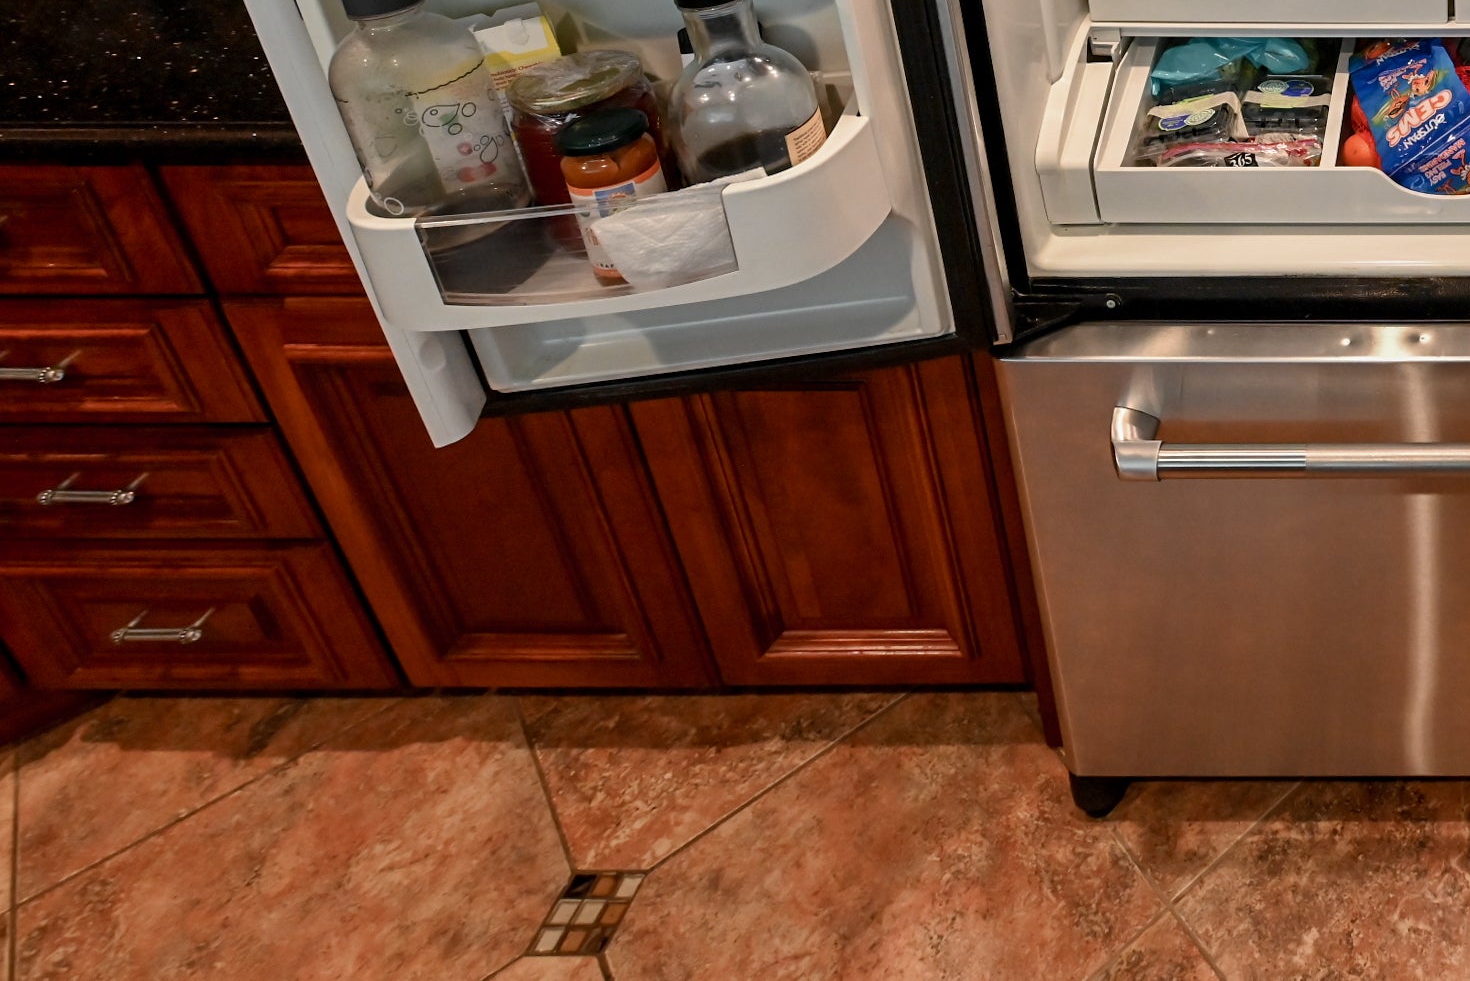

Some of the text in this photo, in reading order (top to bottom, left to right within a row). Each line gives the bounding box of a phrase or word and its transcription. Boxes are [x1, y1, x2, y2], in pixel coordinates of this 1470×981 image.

[1386, 89, 1452, 148] GEMS
[1402, 113, 1445, 149] OUTSPAN
[1230, 154, 1253, 166] 365
[1424, 159, 1452, 179] PEELING
[1429, 171, 1446, 186] EASY
